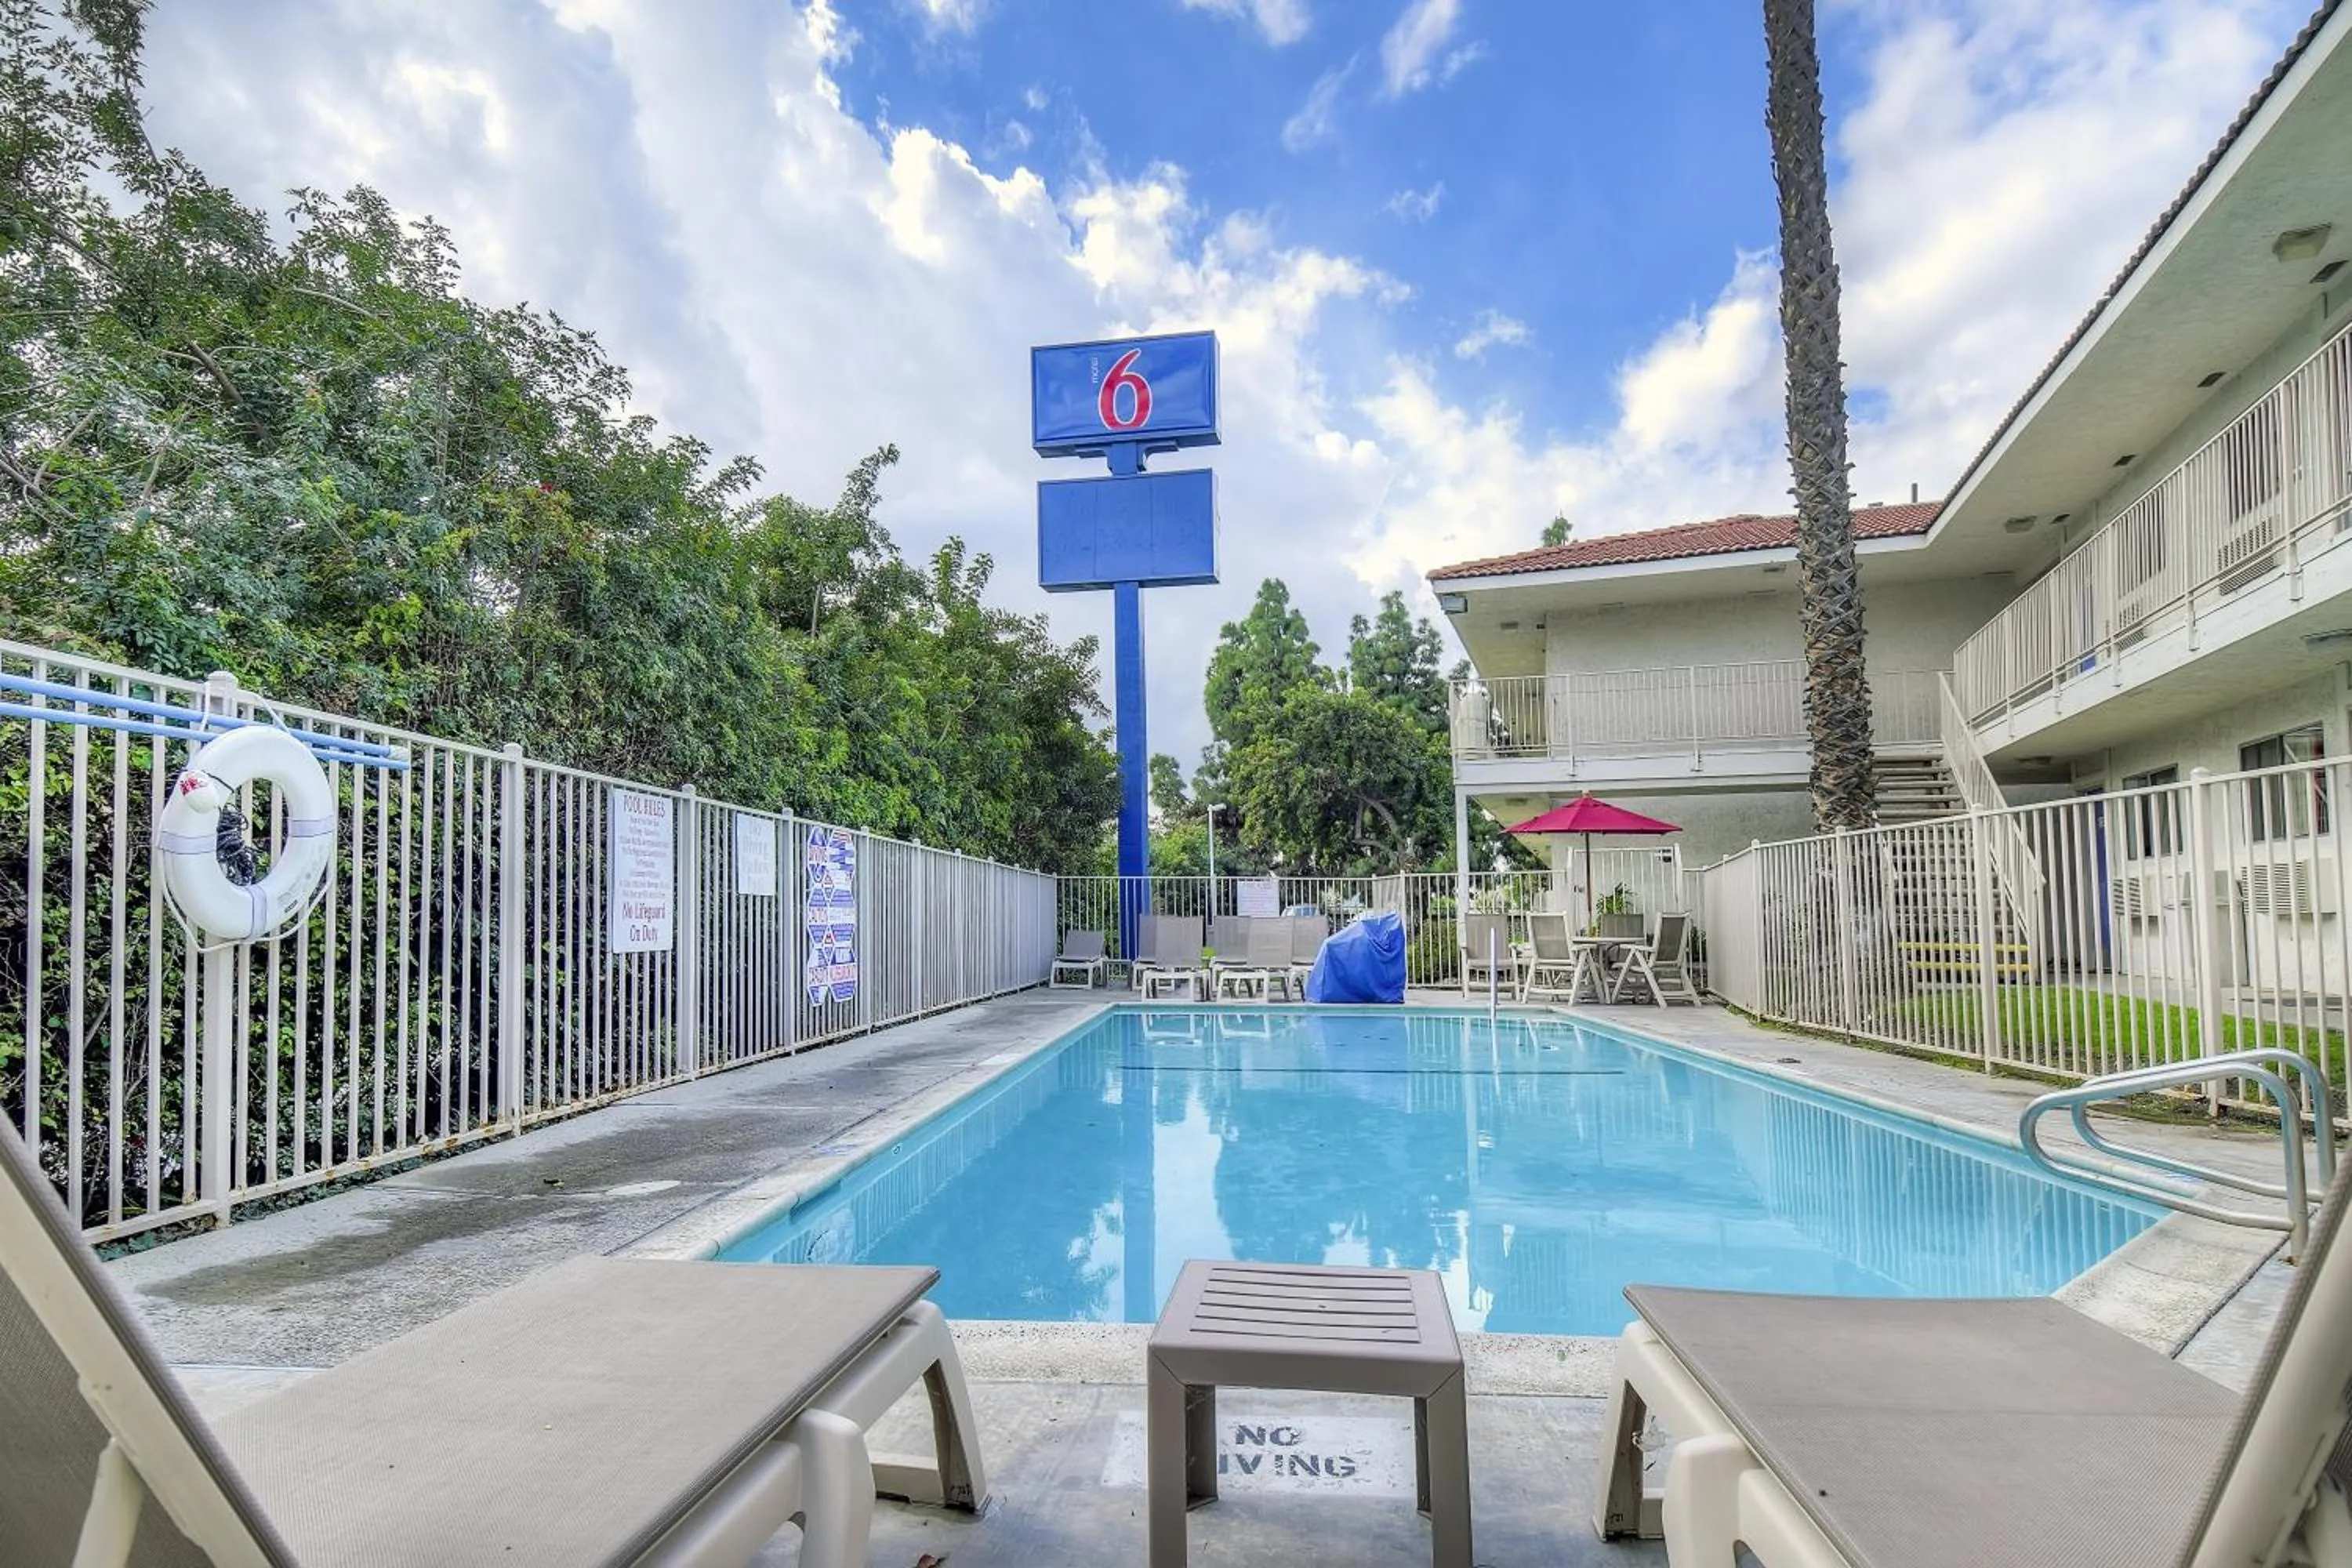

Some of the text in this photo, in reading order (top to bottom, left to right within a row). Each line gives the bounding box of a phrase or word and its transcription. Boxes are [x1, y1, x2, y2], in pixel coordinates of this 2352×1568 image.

[1098, 347, 1152, 430] 6
[634, 901, 666, 923] Lifeguard
[643, 924, 658, 944] Duty
[1235, 1424, 1302, 1446] NO
[1218, 1452, 1356, 1479] IVING
